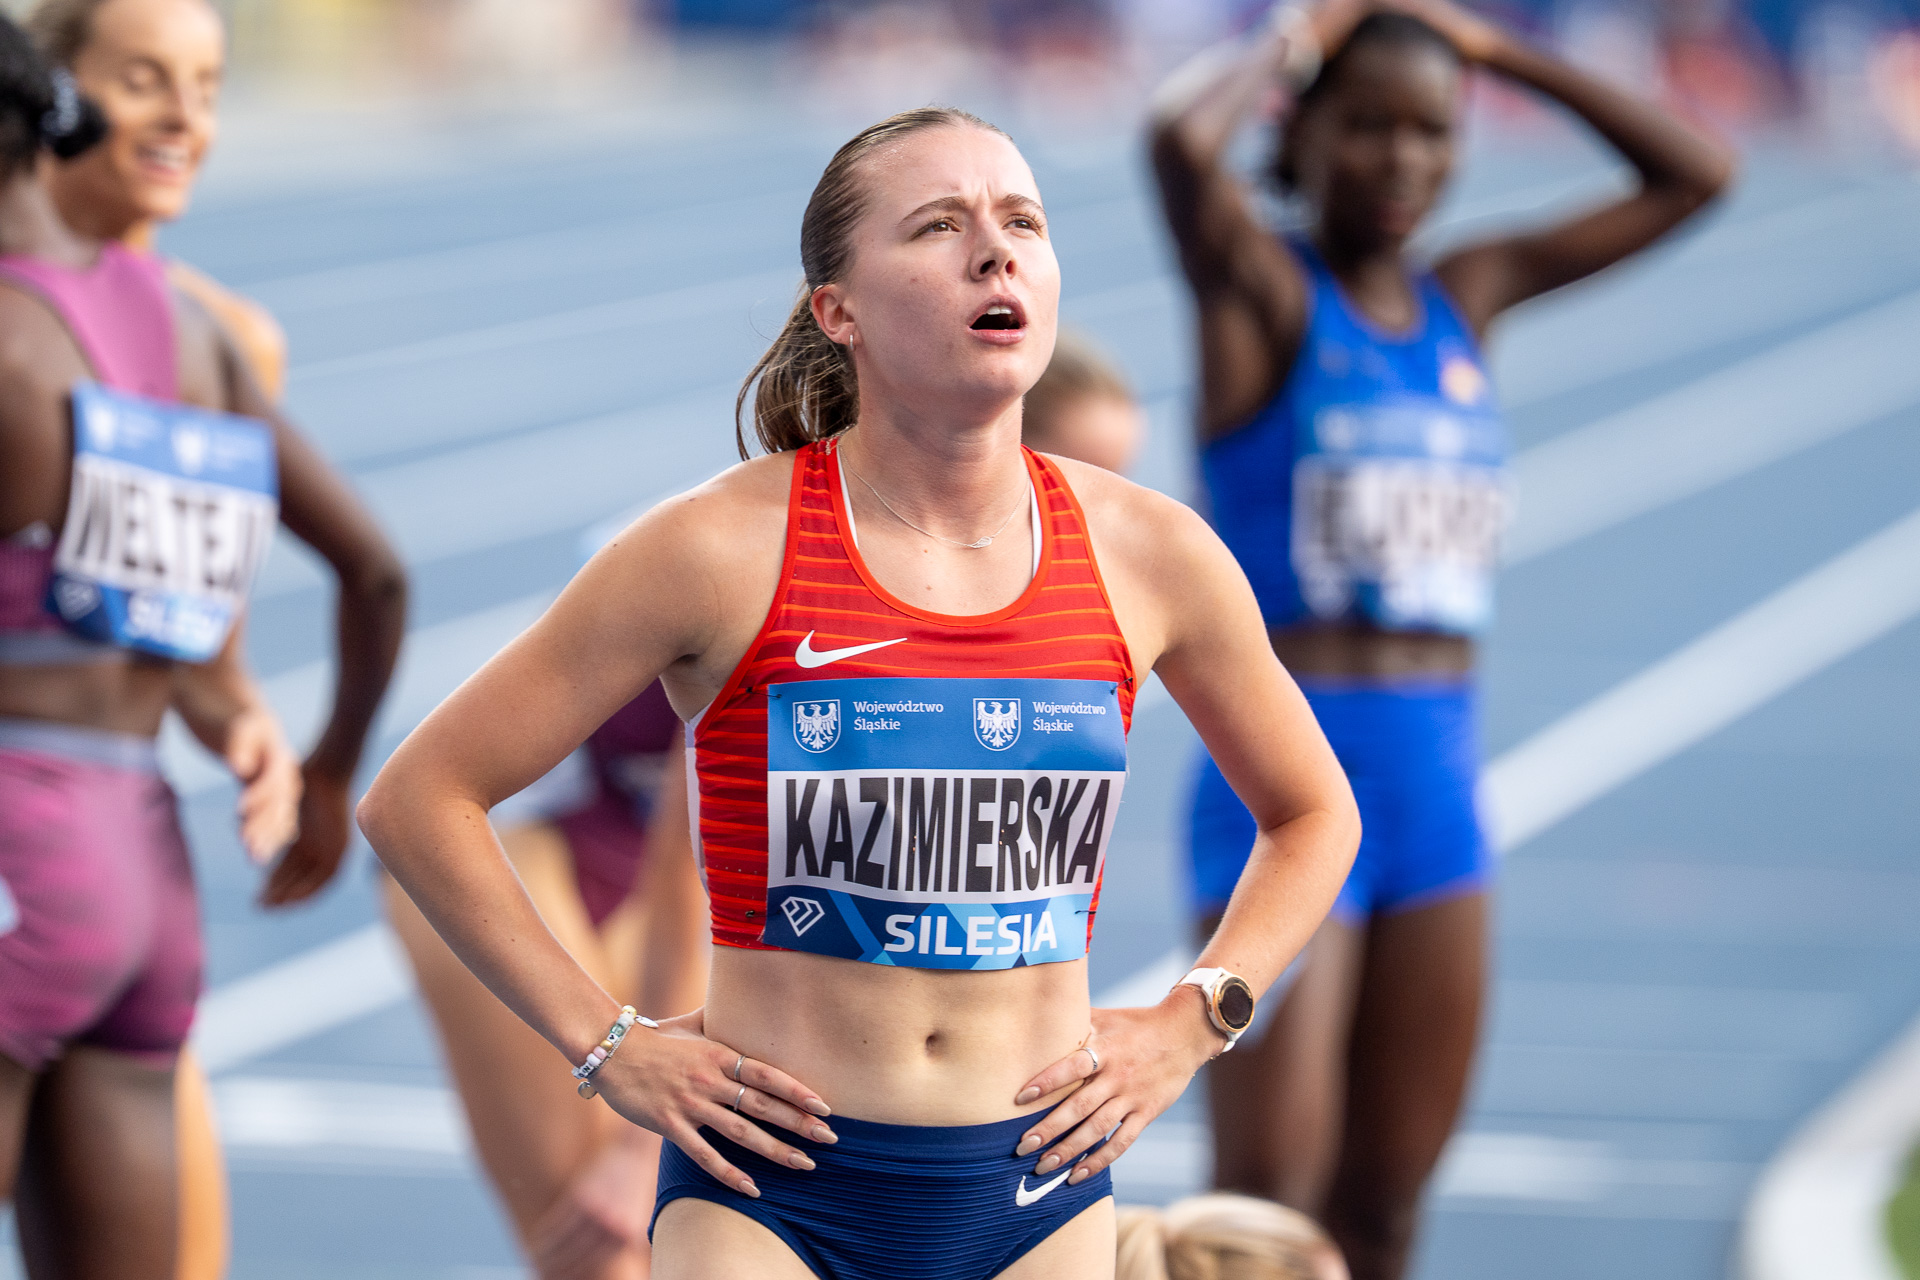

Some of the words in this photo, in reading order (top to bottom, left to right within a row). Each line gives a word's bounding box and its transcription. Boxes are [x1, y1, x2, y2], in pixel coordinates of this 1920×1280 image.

[852, 700, 944, 715] Województwo
[1032, 701, 1107, 716] Województwo
[853, 716, 901, 733] Śląskie
[1032, 717, 1074, 734] Śląskie
[785, 776, 1111, 892] KAZIMIERSKA
[883, 910, 1058, 956] SILESIA
